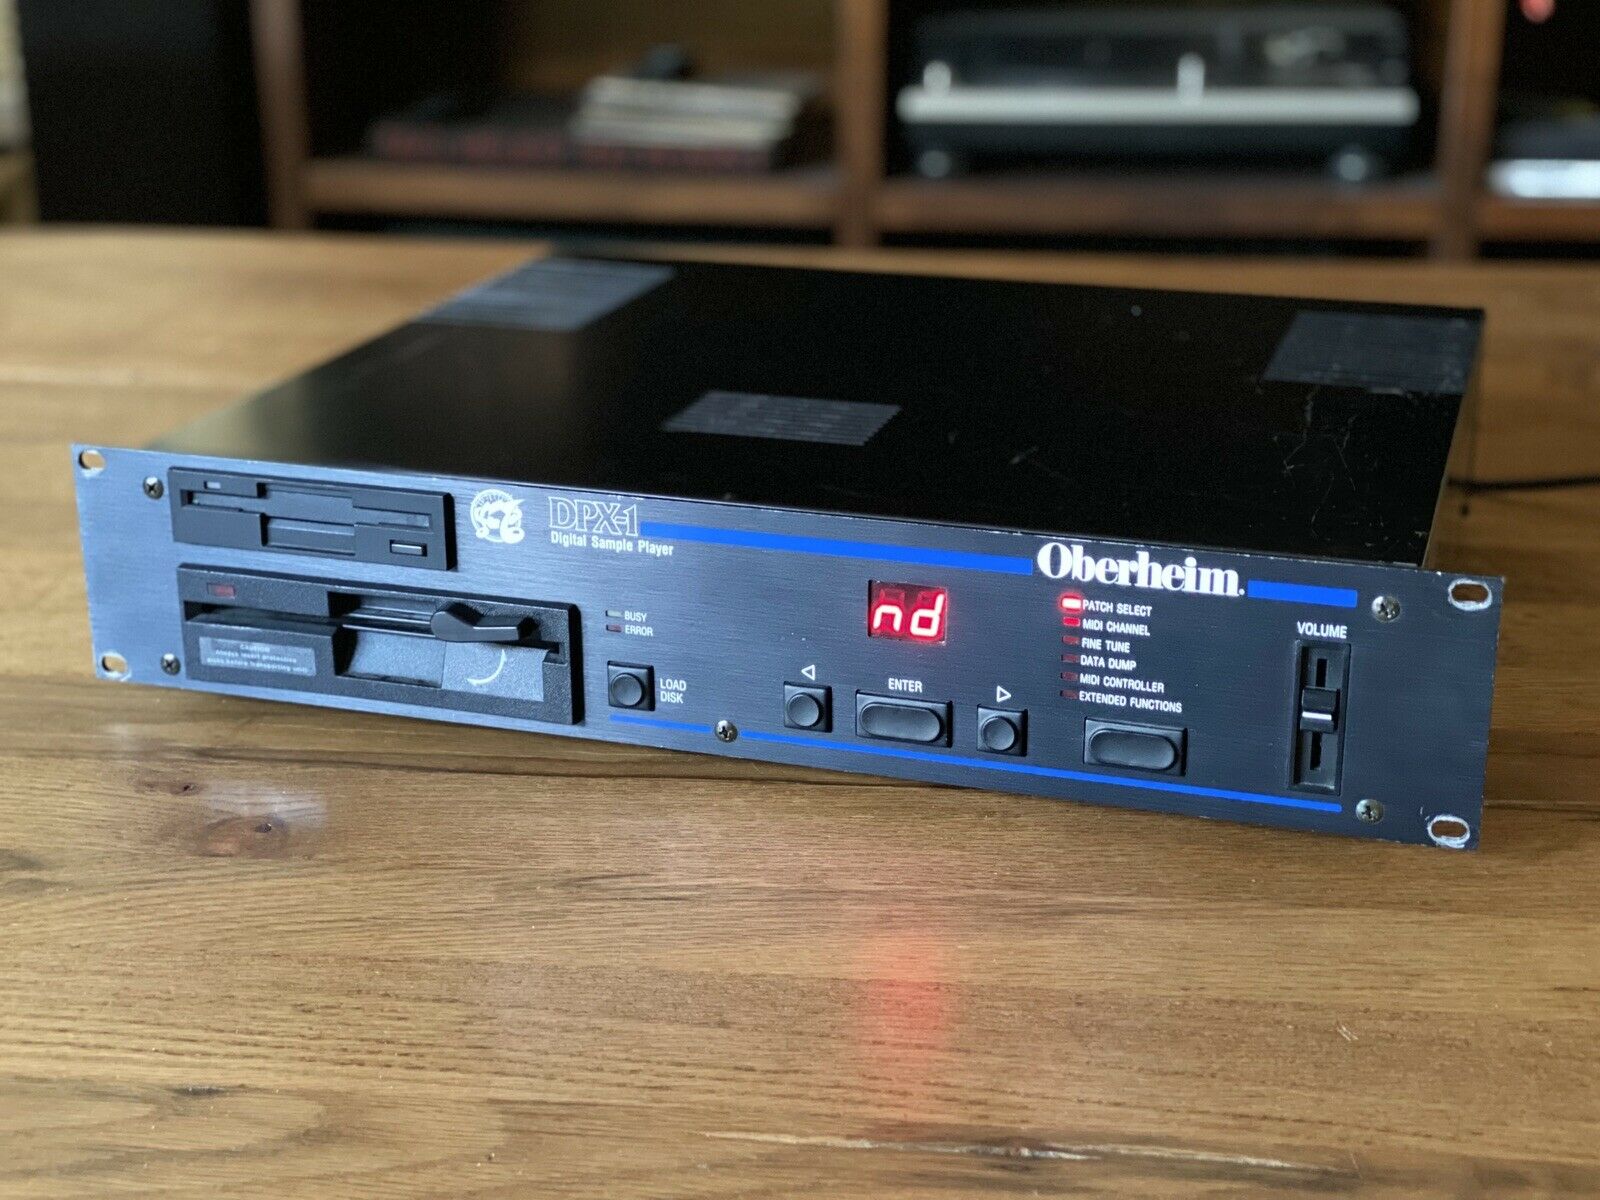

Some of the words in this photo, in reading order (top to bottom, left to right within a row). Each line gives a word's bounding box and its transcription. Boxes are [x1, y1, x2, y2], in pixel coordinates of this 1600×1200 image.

[548, 496, 638, 537] DPX-1
[550, 530, 587, 547] Digital
[591, 535, 633, 552] Sample
[638, 539, 674, 557] Player
[624, 610, 647, 622] BUSY
[1082, 599, 1114, 613] PATCH
[1116, 603, 1152, 617] SELECT
[624, 625, 653, 637] ERROR
[1082, 618, 1103, 631] MIDI
[1106, 621, 1150, 636] CHANNEL
[1297, 621, 1348, 638] VOLUME
[1081, 637, 1102, 650] FINE
[1105, 640, 1130, 653] TUNE
[1080, 654, 1105, 668] DATA
[1108, 657, 1136, 671] DUMP
[659, 678, 686, 692] LOAD
[888, 677, 922, 692] ENTER
[1080, 673, 1100, 685] MIDI
[1103, 676, 1164, 693] CONTROLLER
[660, 690, 683, 704] DISK
[1079, 690, 1127, 707] EXTENDED
[1129, 697, 1182, 713] FUNCTIONS
